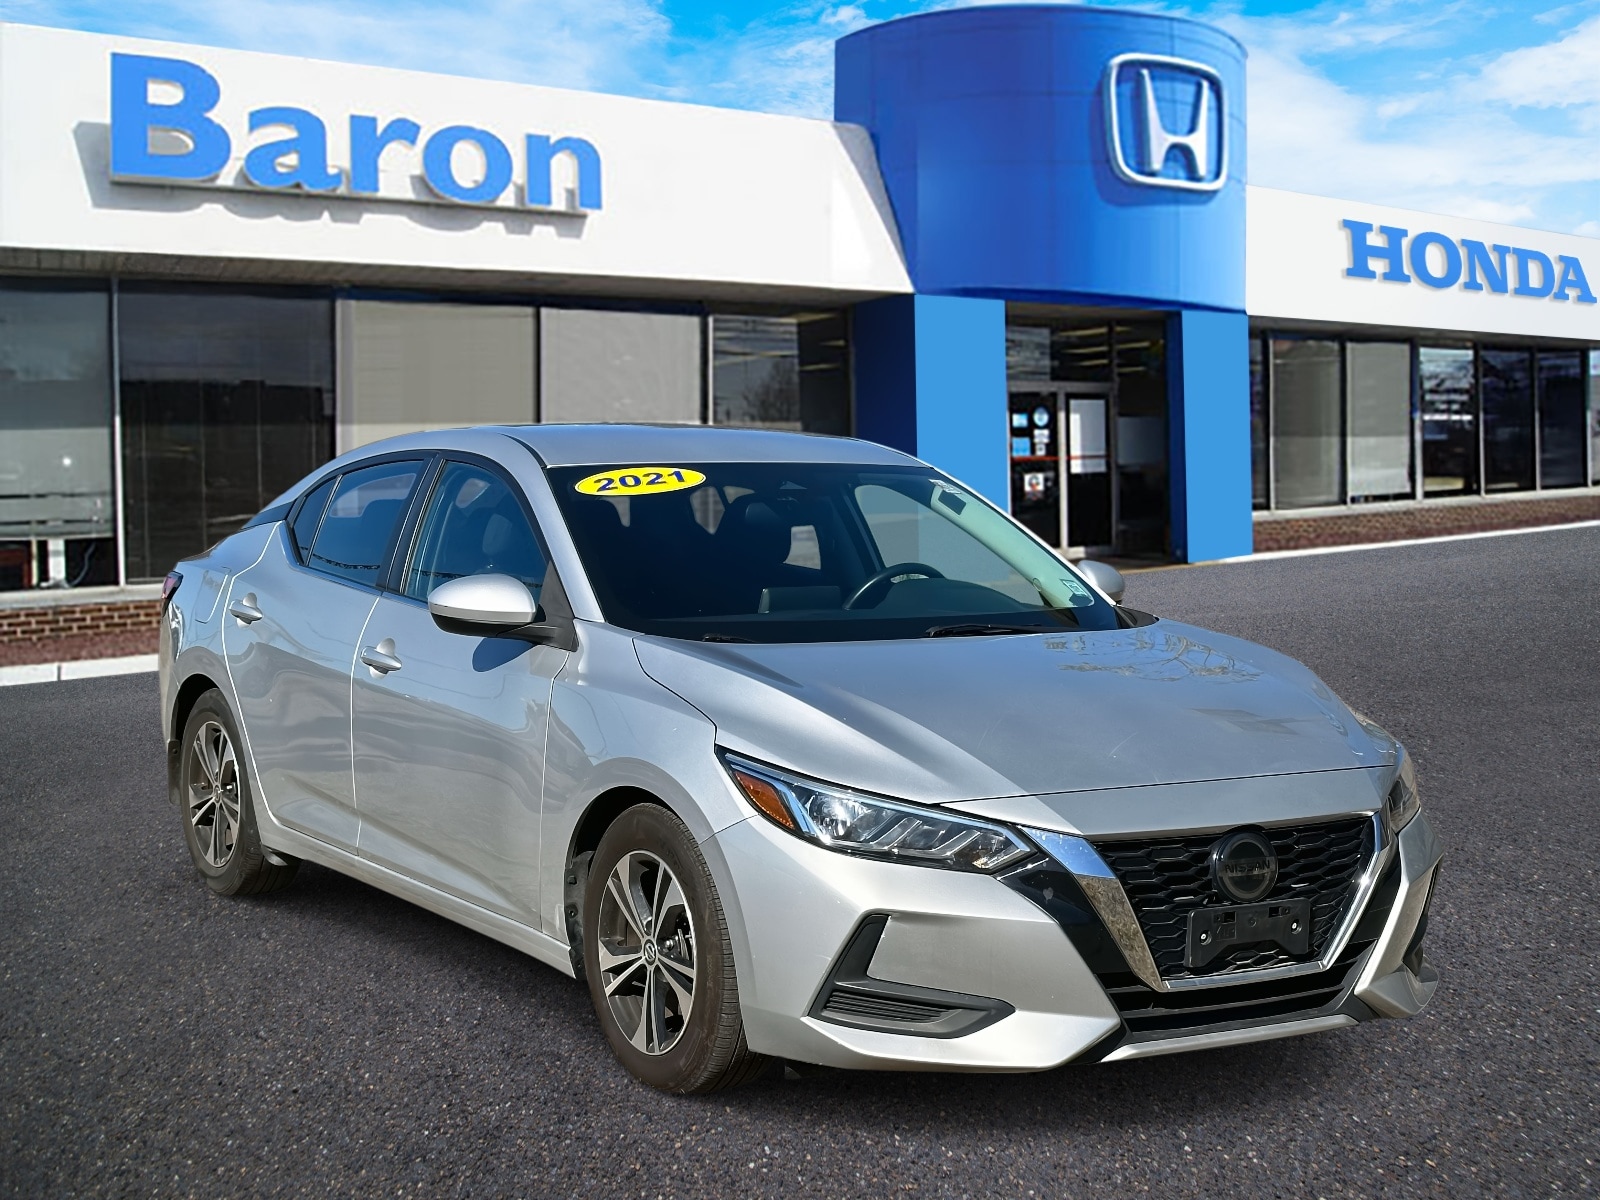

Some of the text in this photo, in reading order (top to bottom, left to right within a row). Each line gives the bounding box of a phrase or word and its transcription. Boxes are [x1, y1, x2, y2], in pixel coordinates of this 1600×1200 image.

[110, 52, 602, 210] Baron
[1342, 218, 1597, 304] HONDA
[594, 470, 685, 492] 2021
[1225, 859, 1271, 873] NISSAN
